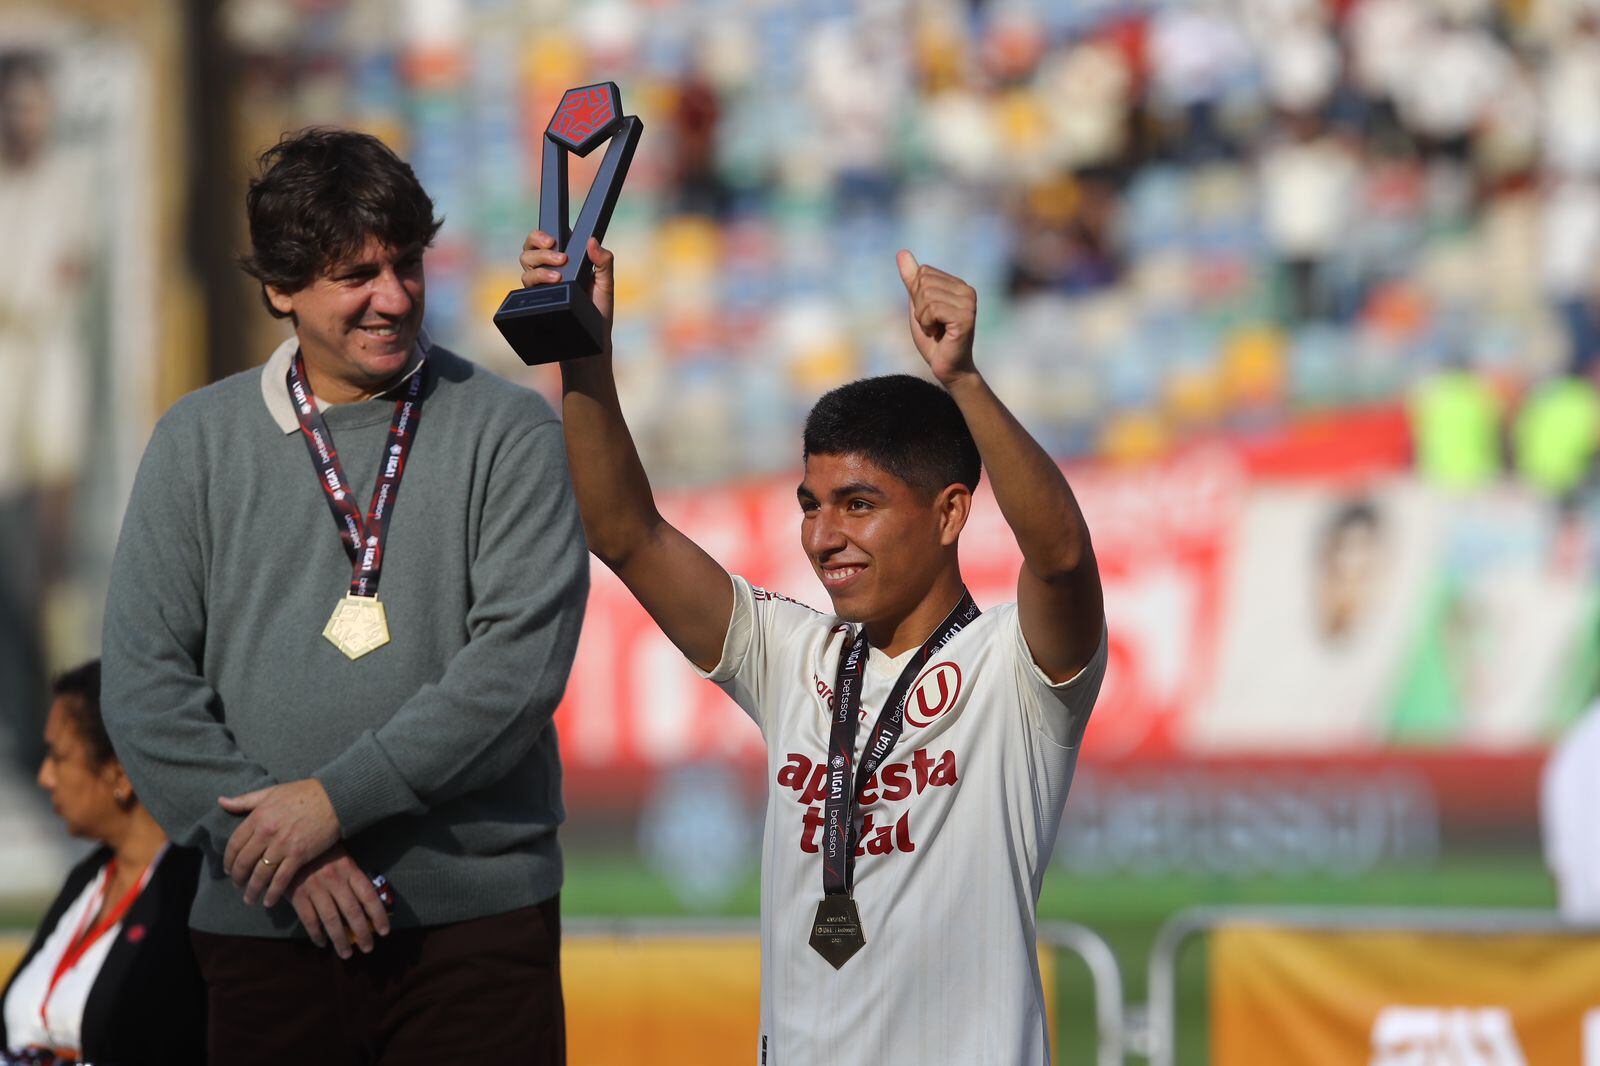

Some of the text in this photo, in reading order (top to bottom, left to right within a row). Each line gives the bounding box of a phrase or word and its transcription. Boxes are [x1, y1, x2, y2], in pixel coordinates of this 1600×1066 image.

[839, 678, 855, 723] betsson
[916, 669, 949, 718] U
[871, 729, 894, 760] LIGA1
[777, 748, 958, 806] apesta
[800, 806, 915, 857] ttal
[829, 771, 844, 858] LIGA1 betsson
